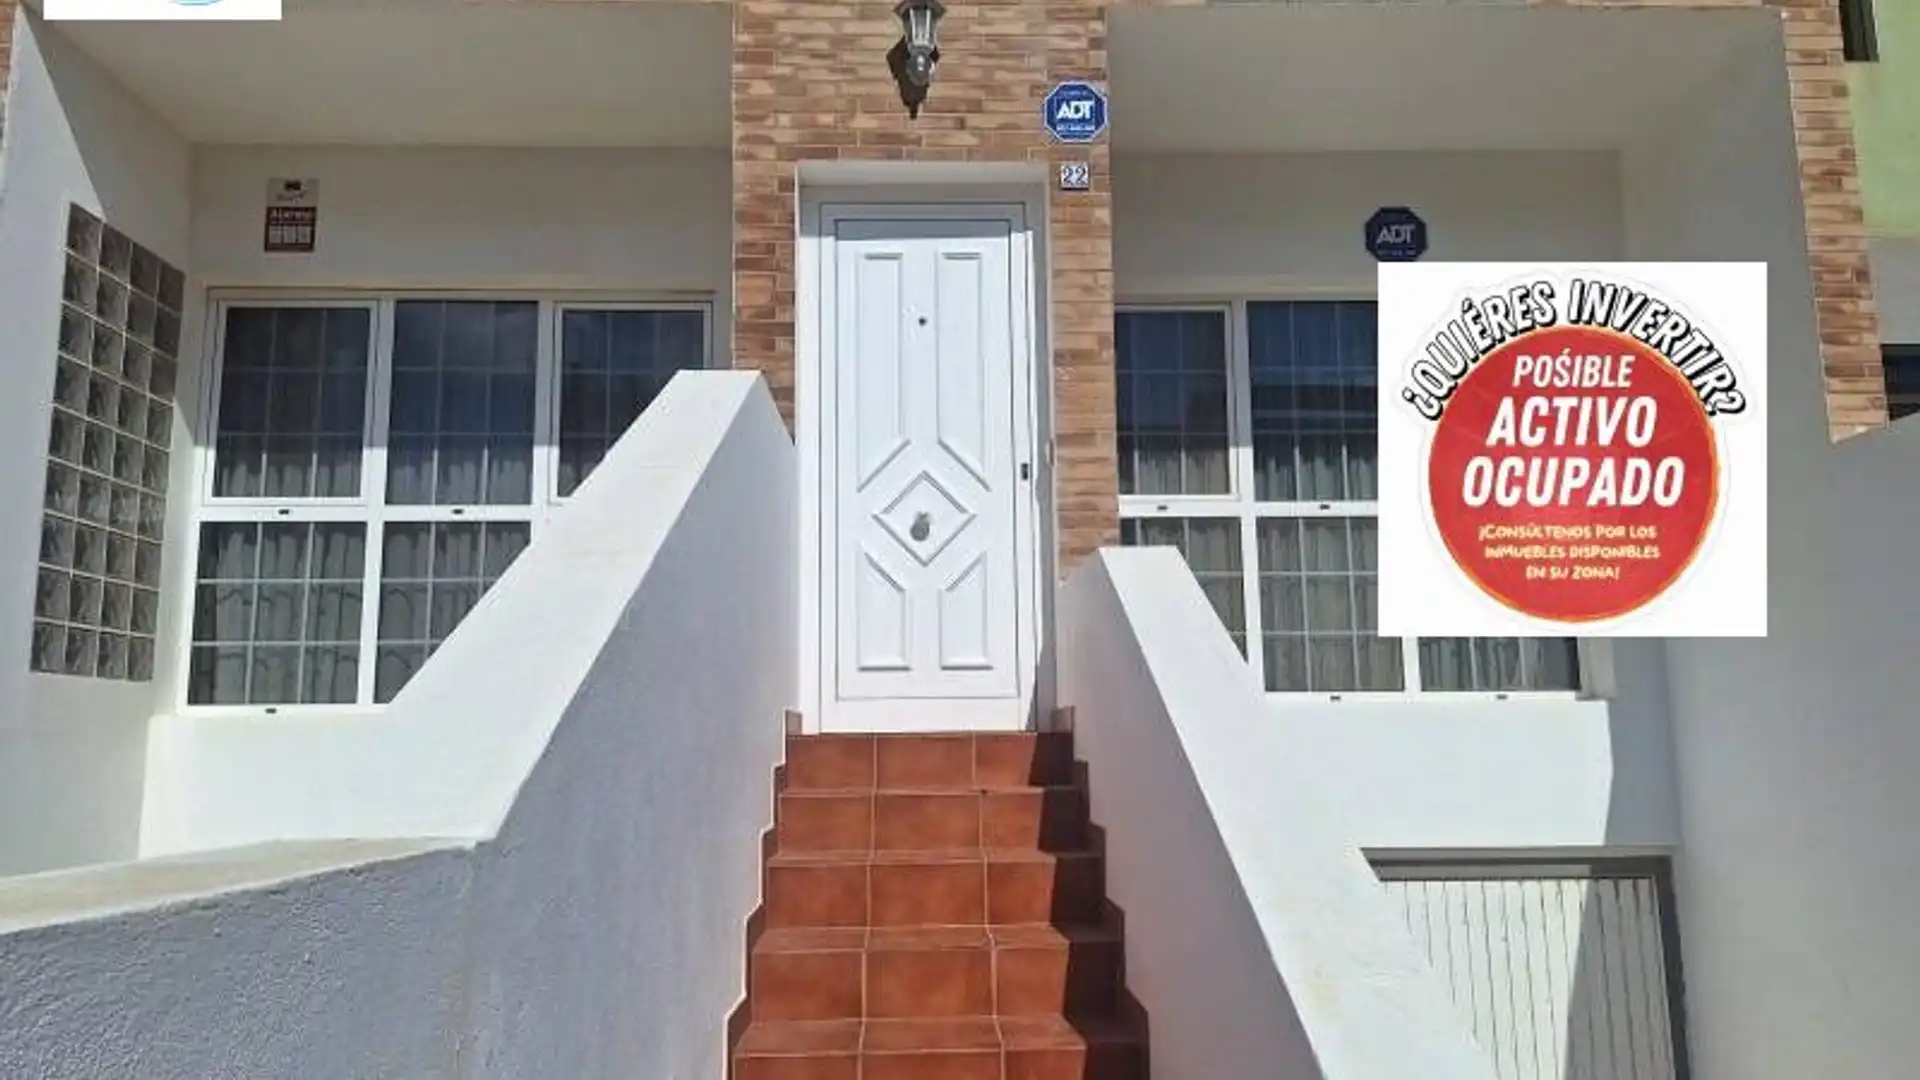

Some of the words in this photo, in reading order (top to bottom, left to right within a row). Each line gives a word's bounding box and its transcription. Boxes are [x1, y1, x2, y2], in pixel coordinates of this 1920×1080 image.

[1056, 100, 1095, 119] ADT
[1063, 165, 1087, 185] 22
[1376, 224, 1416, 244] ADT
